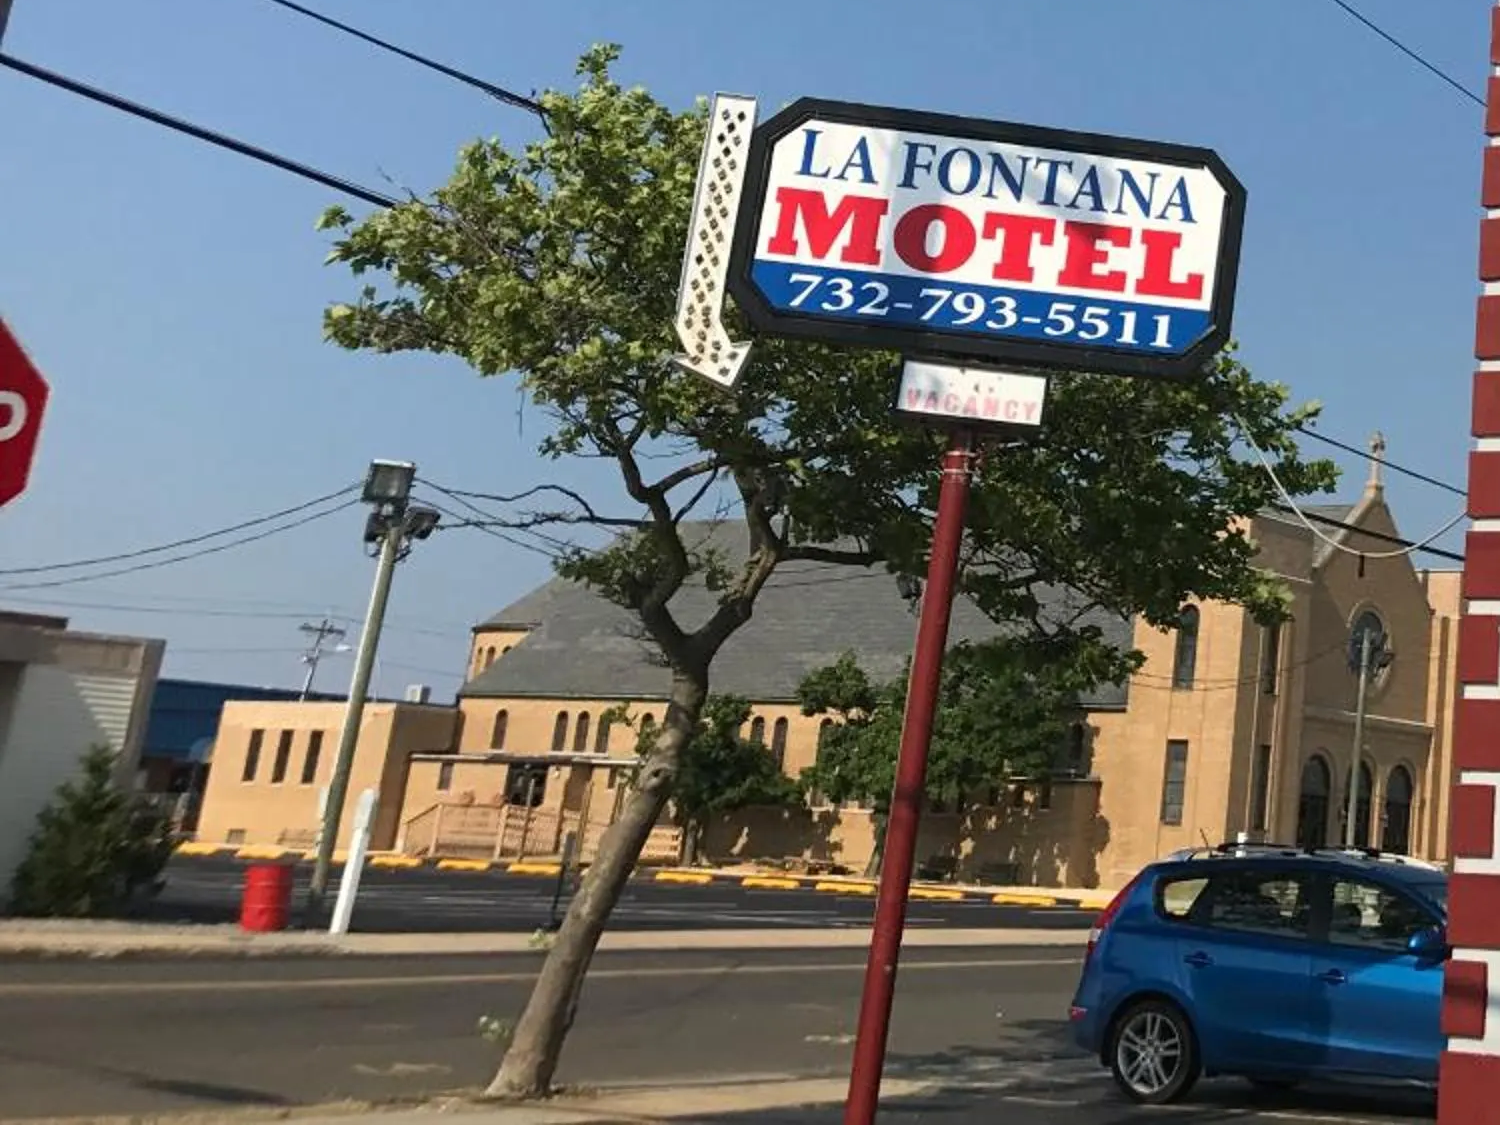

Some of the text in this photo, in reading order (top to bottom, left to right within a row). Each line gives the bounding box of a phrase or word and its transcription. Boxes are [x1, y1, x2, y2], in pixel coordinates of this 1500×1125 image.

[794, 129, 1197, 224] LA FONTANA
[767, 186, 1204, 301] MOTEL
[788, 272, 1172, 349] 732-793-5511
[907, 387, 1038, 421] VACANCY
